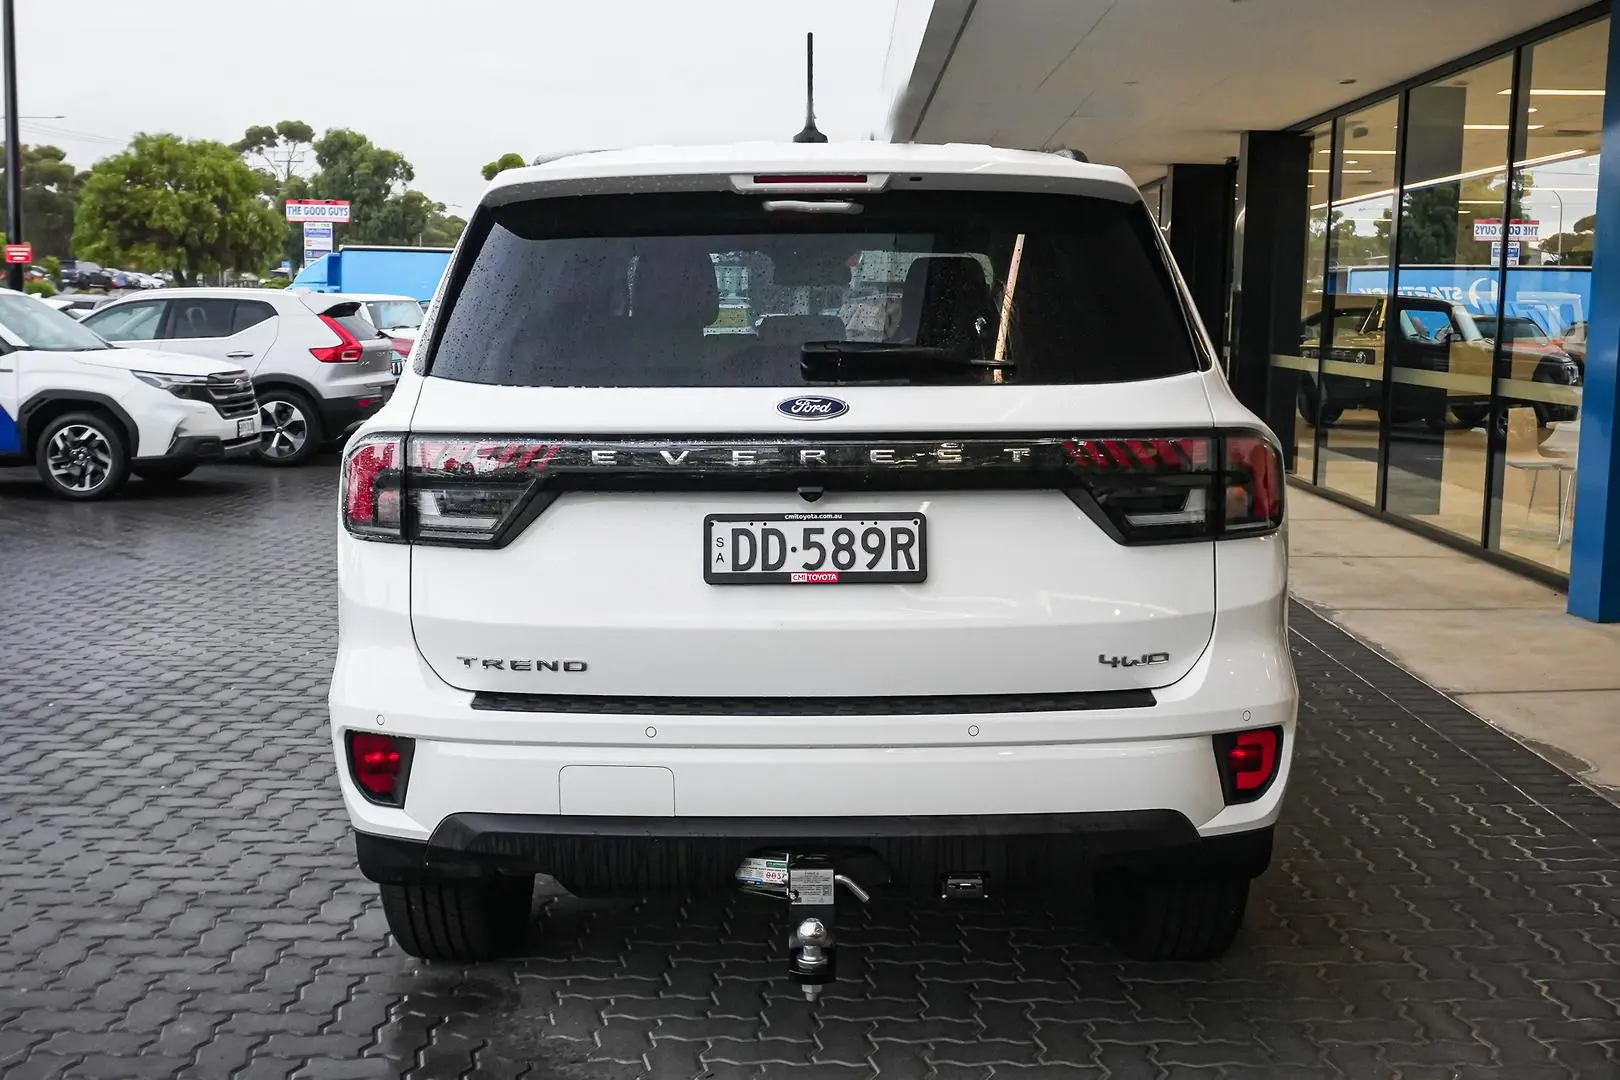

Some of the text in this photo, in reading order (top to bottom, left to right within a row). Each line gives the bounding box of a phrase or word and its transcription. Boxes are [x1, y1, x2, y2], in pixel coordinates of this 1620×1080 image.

[287, 206, 348, 216] THE GOOD GUYS
[791, 399, 832, 413] Ford
[591, 447, 1032, 465] EVEREST
[807, 573, 838, 581] TOYOTA
[456, 656, 588, 672] TREND
[1098, 652, 1170, 668] 4WD
